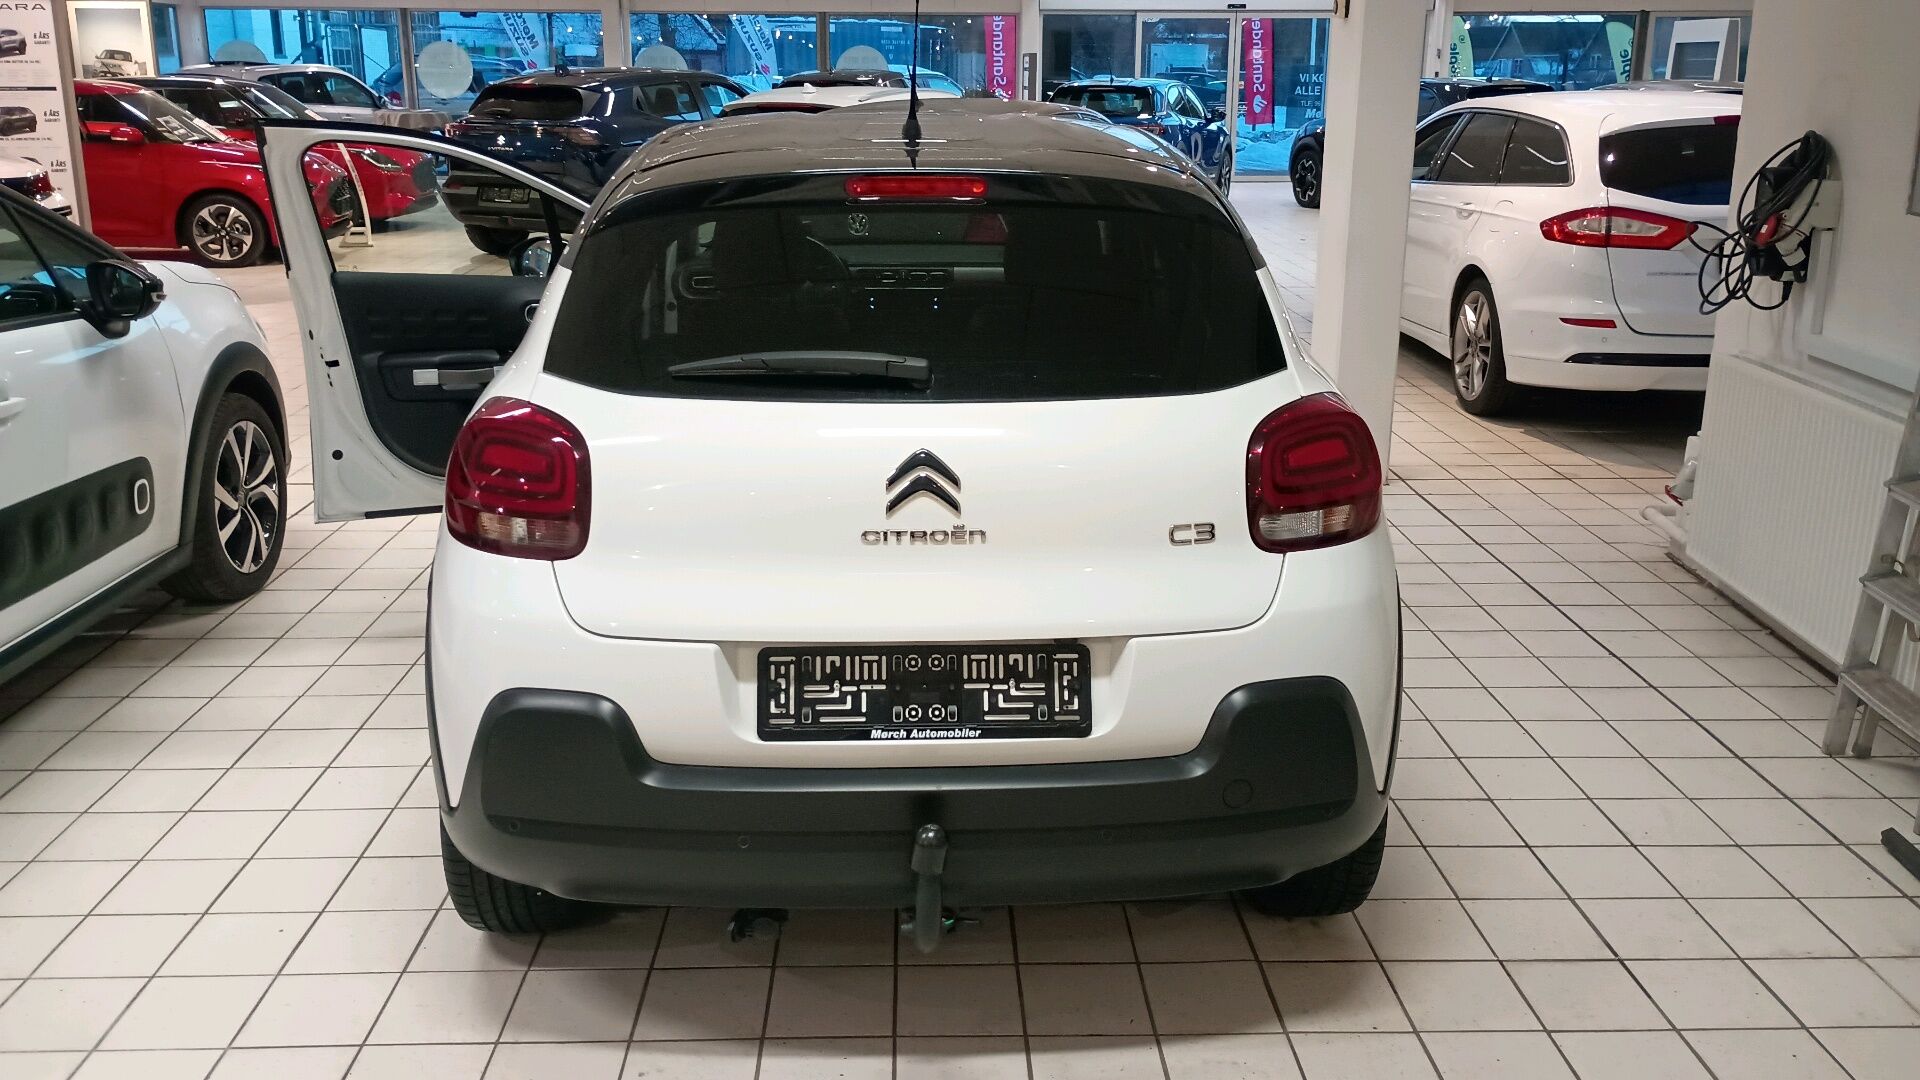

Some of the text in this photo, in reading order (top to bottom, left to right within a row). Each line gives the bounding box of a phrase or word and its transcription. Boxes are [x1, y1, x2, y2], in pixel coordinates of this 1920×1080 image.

[1295, 85, 1321, 95] ALLE
[860, 523, 986, 546] CITROËN
[1168, 522, 1216, 547] C3
[870, 728, 981, 739] Mørch Automobiler
